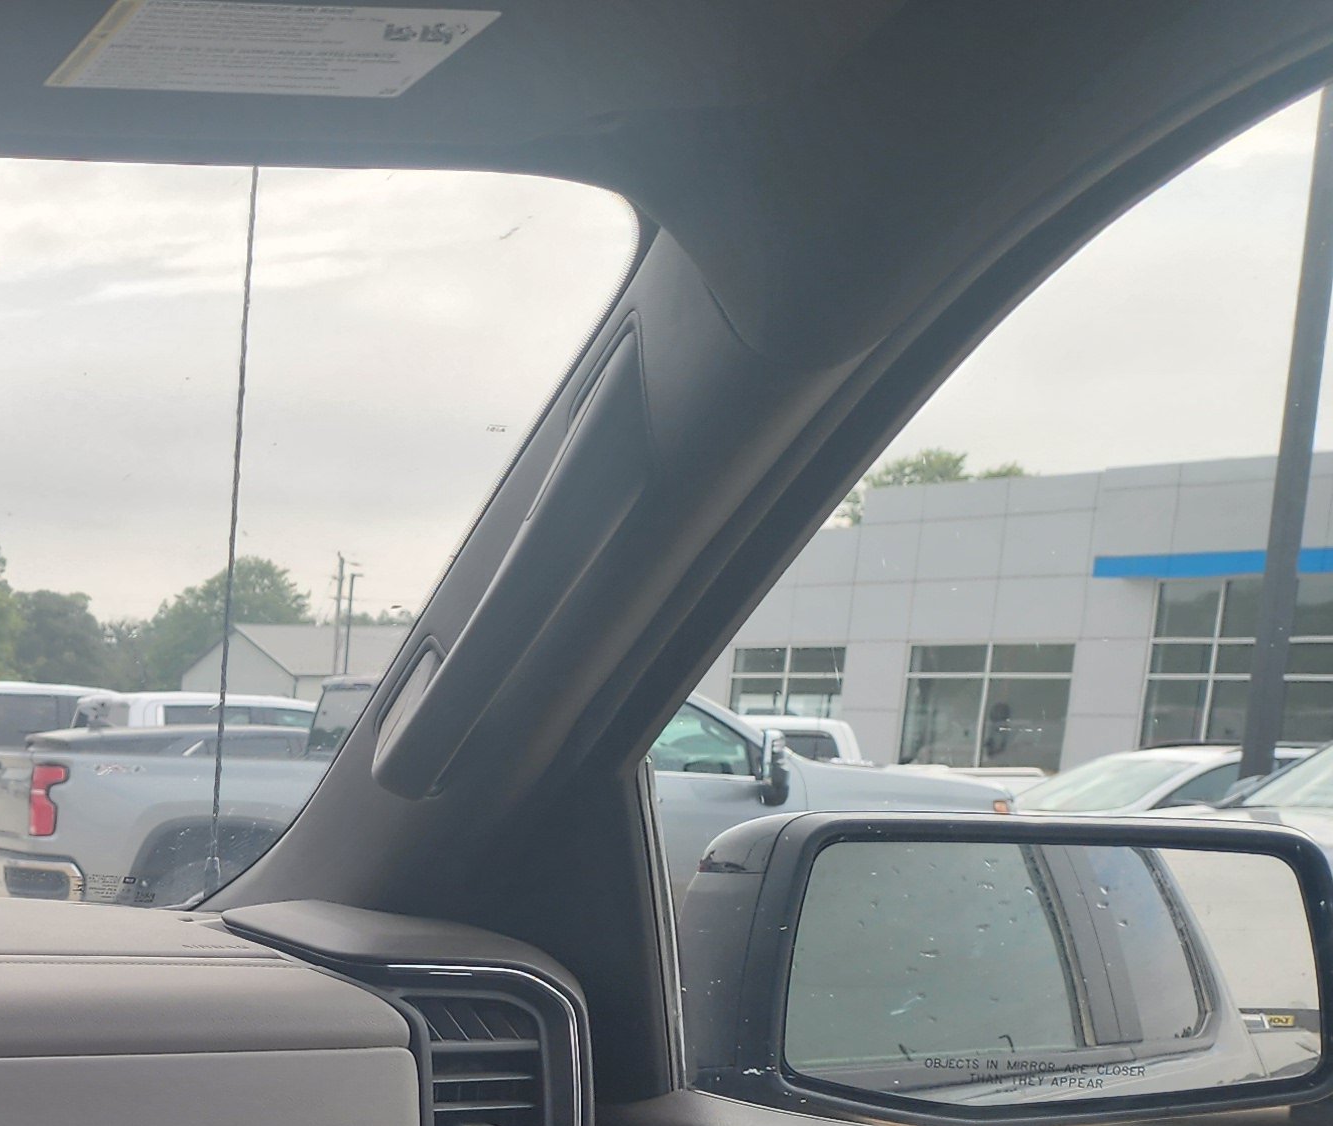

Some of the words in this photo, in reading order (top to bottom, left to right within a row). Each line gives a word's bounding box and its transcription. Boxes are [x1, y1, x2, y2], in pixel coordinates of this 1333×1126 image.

[924, 1058, 980, 1070] OBJECTS
[986, 1059, 999, 1070] IN
[1006, 1060, 1056, 1073] MIRROR
[1064, 1063, 1088, 1075] ARE
[1096, 1063, 1146, 1077] CLOSER
[969, 1073, 1003, 1085] THAN
[1013, 1074, 1044, 1087] THEY
[1051, 1076, 1104, 1089] APPEAR
